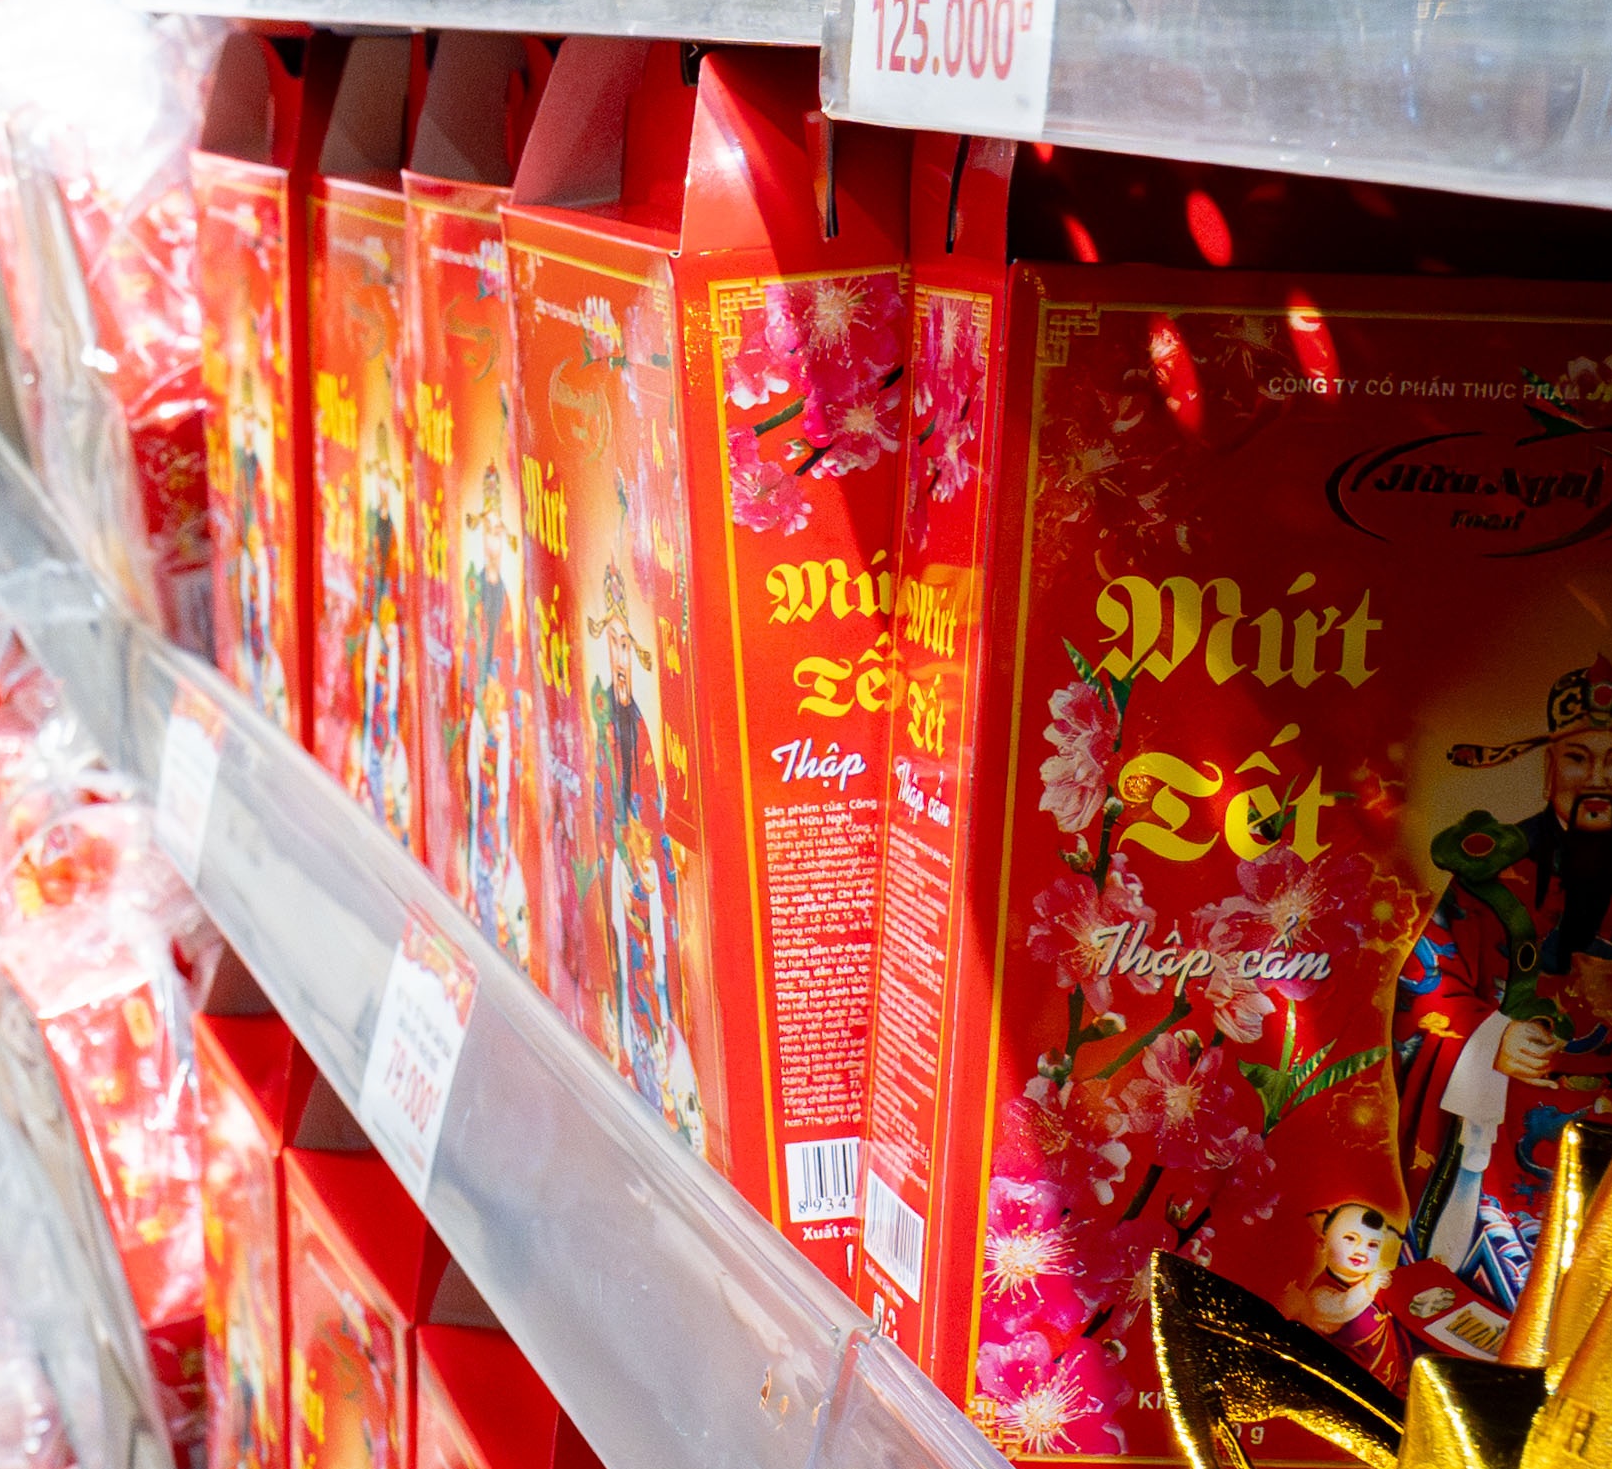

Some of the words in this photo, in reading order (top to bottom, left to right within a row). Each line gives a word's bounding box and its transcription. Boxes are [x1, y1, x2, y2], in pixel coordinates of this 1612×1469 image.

[1268, 374, 1329, 396] CÔNG
[1333, 377, 1359, 395] TY
[1365, 375, 1394, 397] CỔ
[1400, 374, 1455, 398] PHẦN
[1462, 381, 1516, 400] THỰC
[905, 580, 958, 661] Mứt
[1092, 572, 1383, 689] Mứt
[906, 672, 946, 759] Tết
[771, 737, 867, 792] Thập
[895, 760, 925, 825] Thập
[1117, 723, 1336, 864] Tết
[1092, 920, 1215, 998] Thập
[1238, 914, 1332, 980] cẩm
[802, 1222, 840, 1241] Xuất
